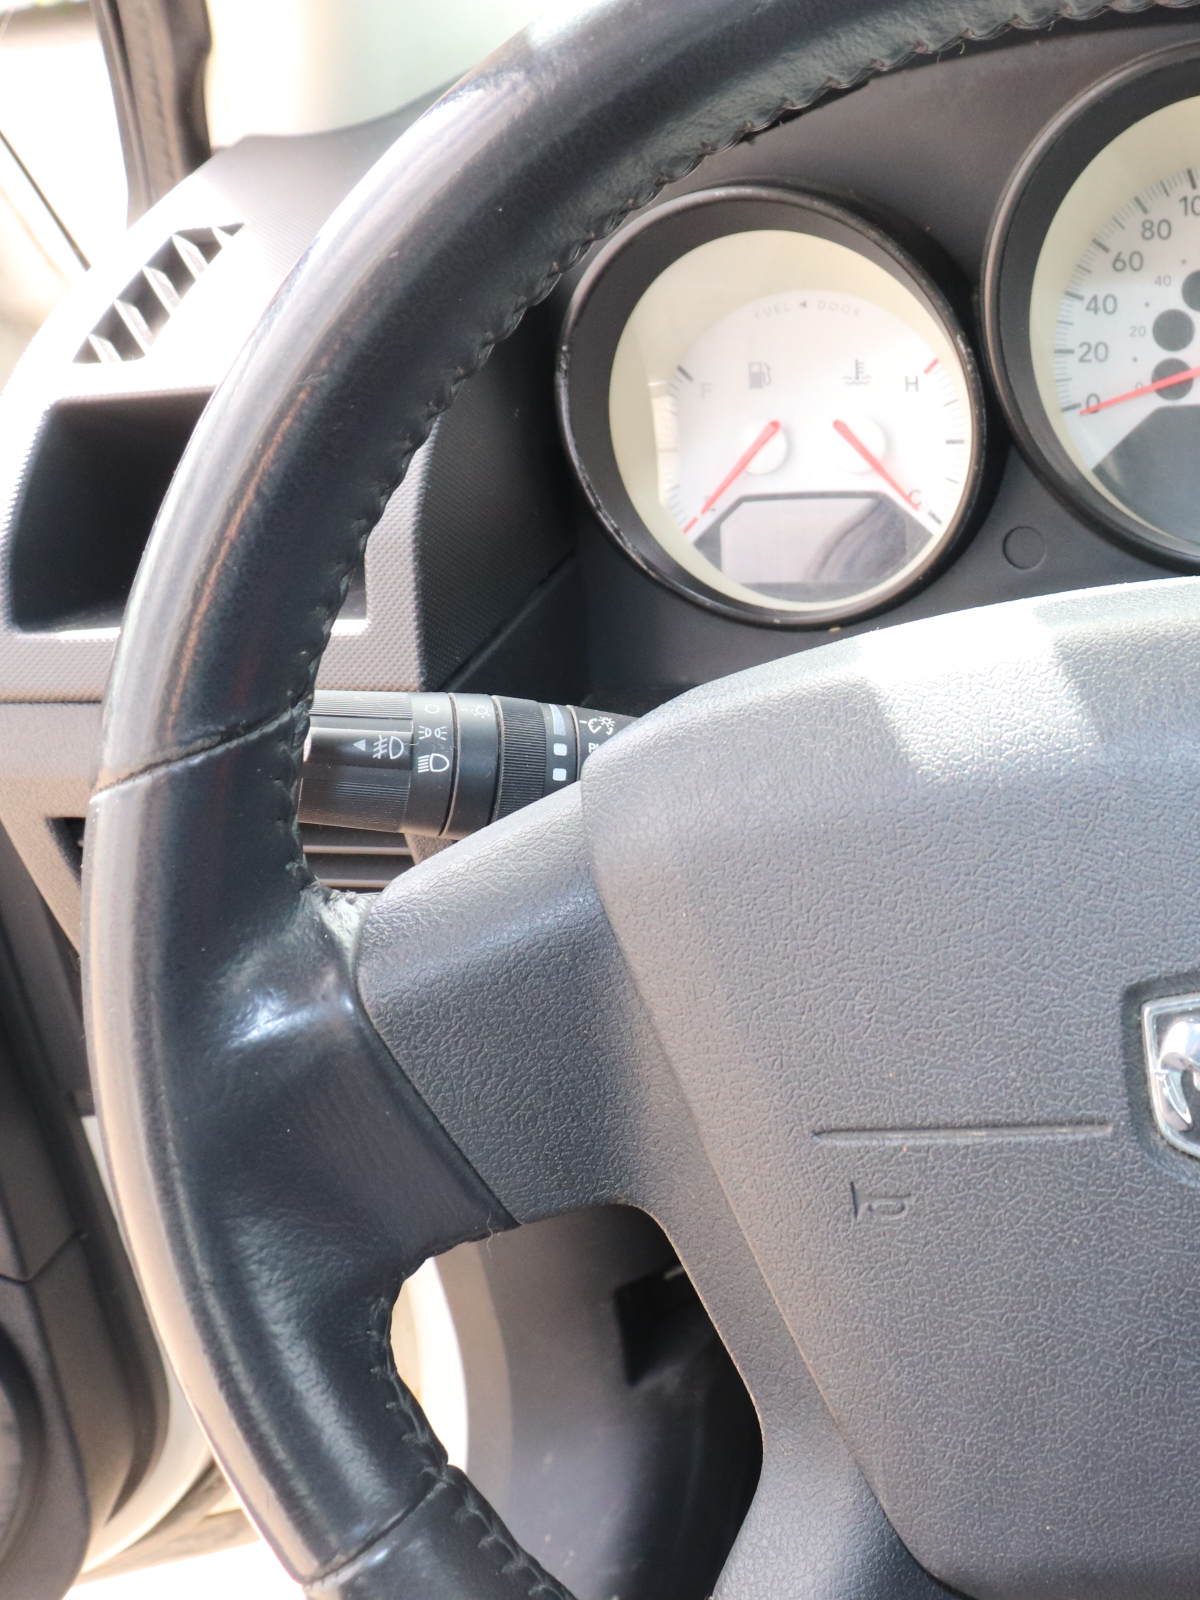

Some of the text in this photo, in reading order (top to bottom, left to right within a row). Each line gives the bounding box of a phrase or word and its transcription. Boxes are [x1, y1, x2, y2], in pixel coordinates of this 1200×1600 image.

[1141, 220, 1172, 240] 80
[1112, 251, 1144, 272] 60
[1154, 275, 1172, 287] 40
[754, 301, 862, 319] FUEL DOOR
[1085, 294, 1117, 315] 40
[1129, 326, 1147, 337] 20
[1078, 342, 1109, 363] 20
[700, 382, 712, 399] F
[904, 376, 920, 392] H
[1086, 394, 1101, 414] 0
